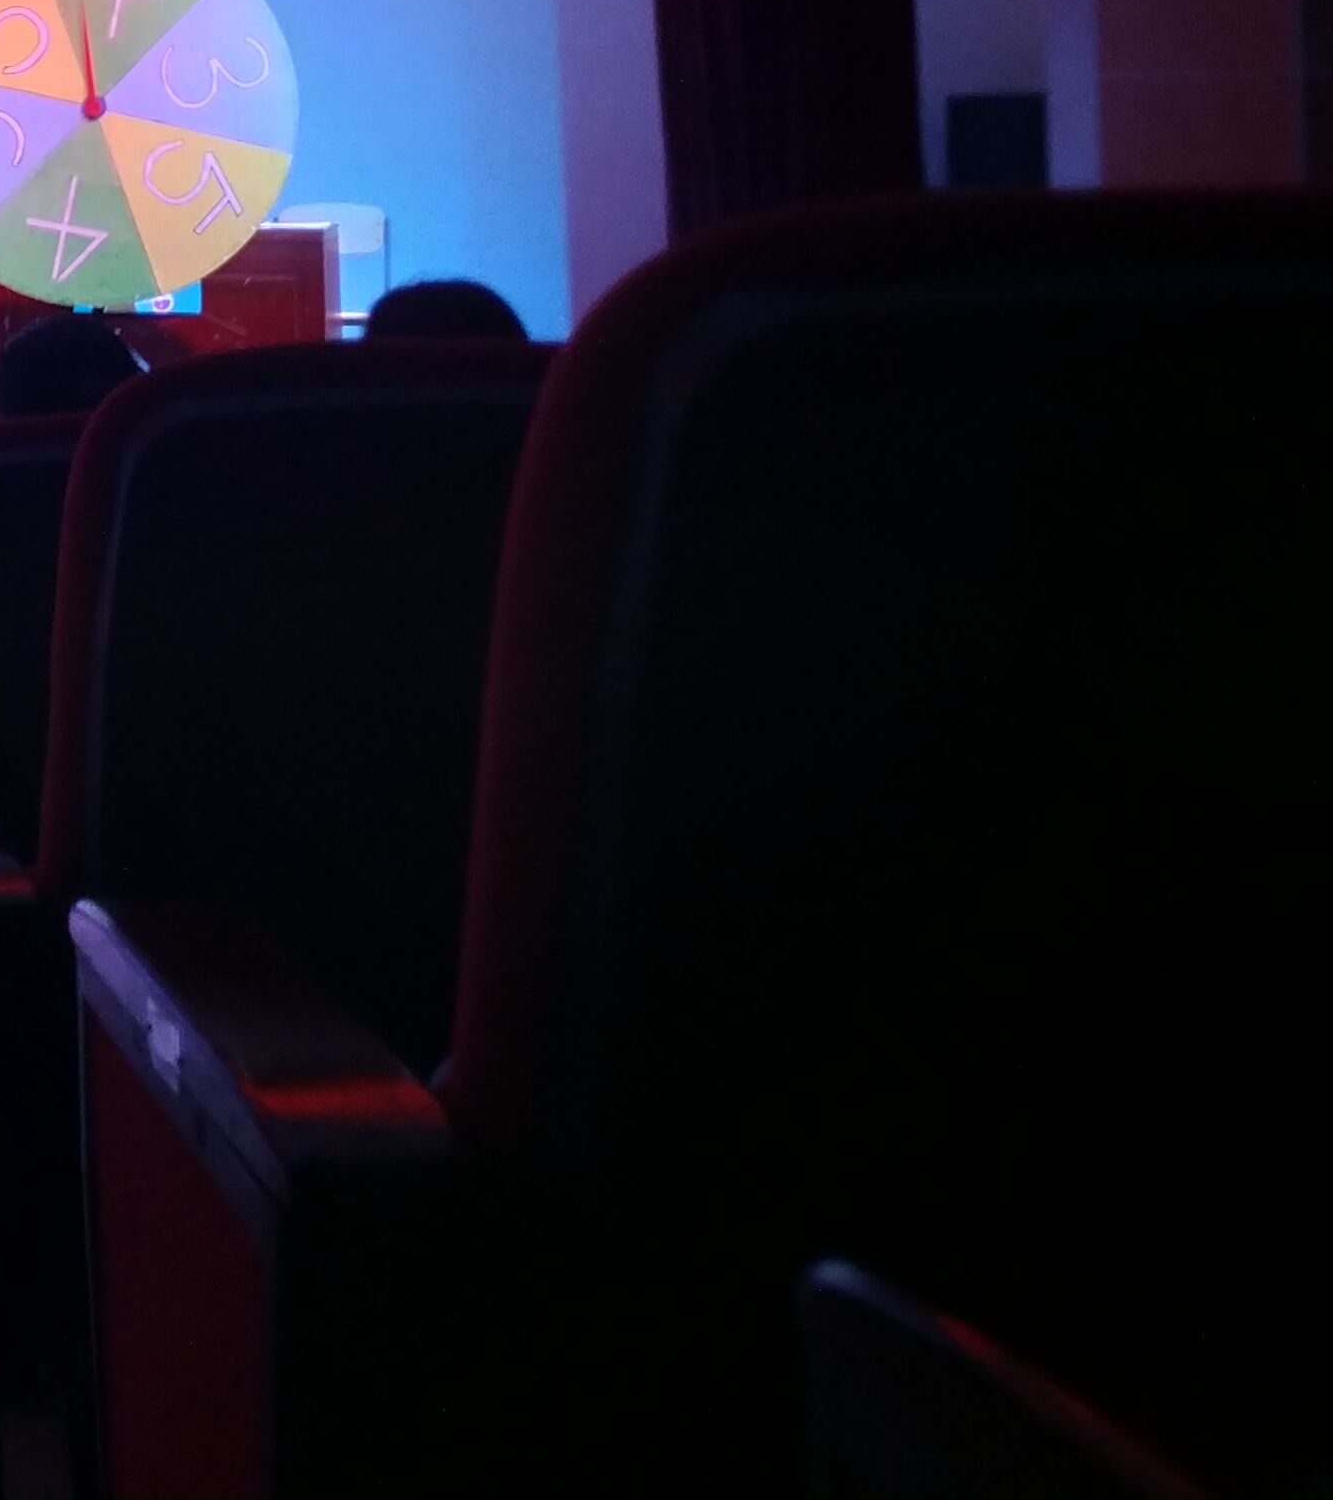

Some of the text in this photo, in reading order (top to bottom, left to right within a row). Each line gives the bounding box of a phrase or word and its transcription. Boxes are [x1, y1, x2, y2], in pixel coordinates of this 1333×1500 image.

[160, 36, 271, 110] 3
[25, 174, 110, 282] 4
[143, 139, 245, 235] 5
